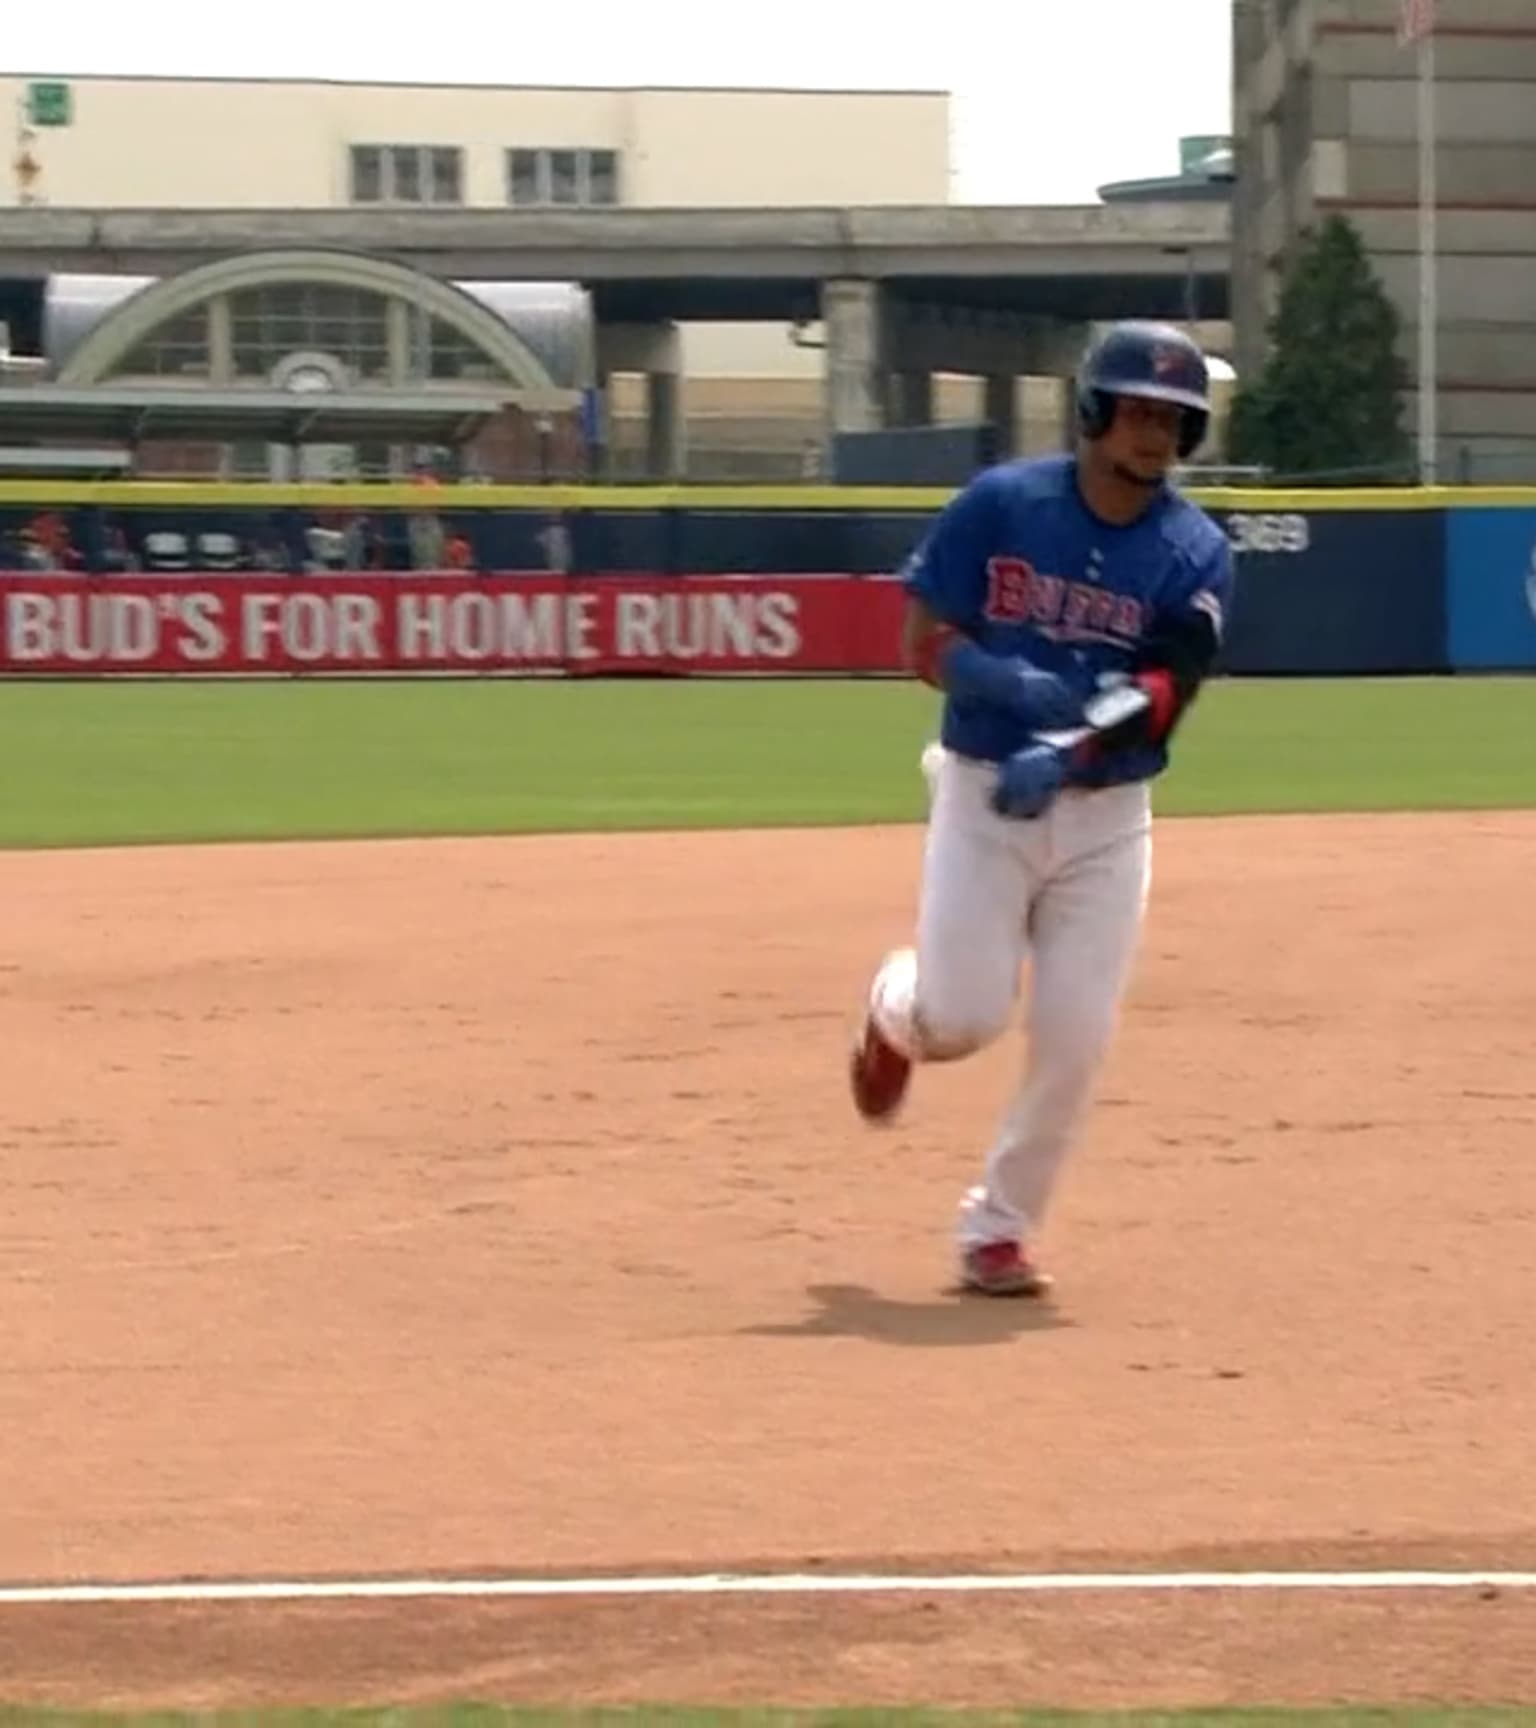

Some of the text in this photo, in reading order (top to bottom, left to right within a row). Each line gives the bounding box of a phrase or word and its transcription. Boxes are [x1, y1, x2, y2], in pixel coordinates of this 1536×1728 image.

[6, 592, 799, 660] BUD'S FOR HOME RUNS
